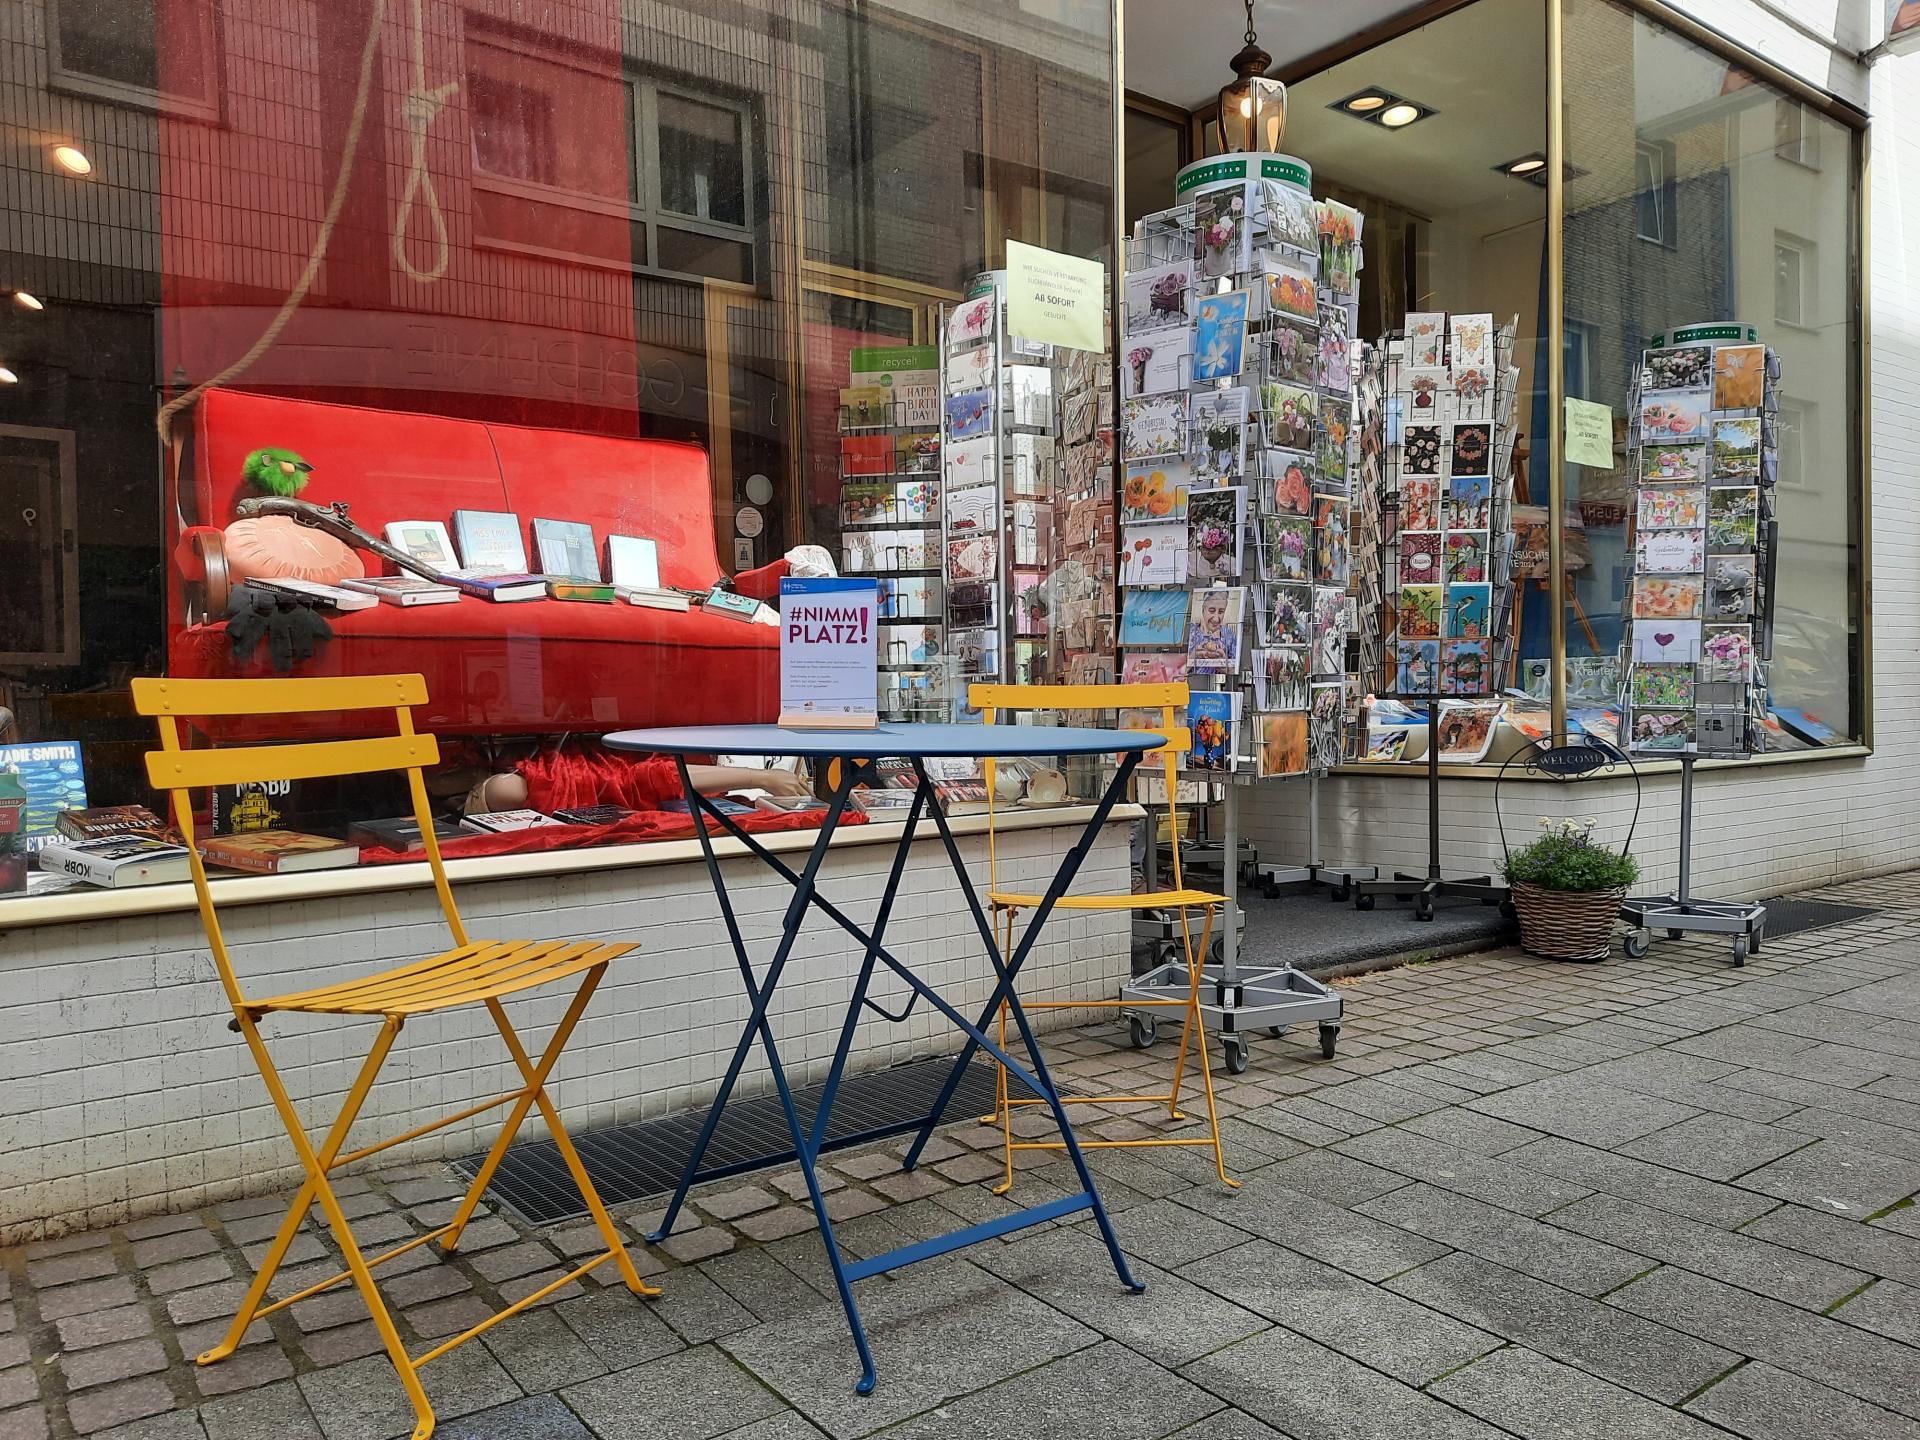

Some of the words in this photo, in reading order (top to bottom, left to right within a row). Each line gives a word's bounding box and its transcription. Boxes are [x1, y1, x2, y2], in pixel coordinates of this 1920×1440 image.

[1034, 292, 1045, 302] AB
[1047, 295, 1076, 309] SOFORT
[907, 385, 938, 398] HAPPY
[907, 397, 937, 410] BIRTH
[912, 410, 936, 421] DAY!
[850, 536, 874, 554] Alles
[789, 606, 858, 622] #NIMM
[789, 607, 869, 644] PLATZ!
[32, 746, 75, 761] SMITH
[1540, 754, 1603, 765] WELCOME
[84, 819, 160, 833] DUNKELZEIT
[64, 858, 90, 878] KOBR
